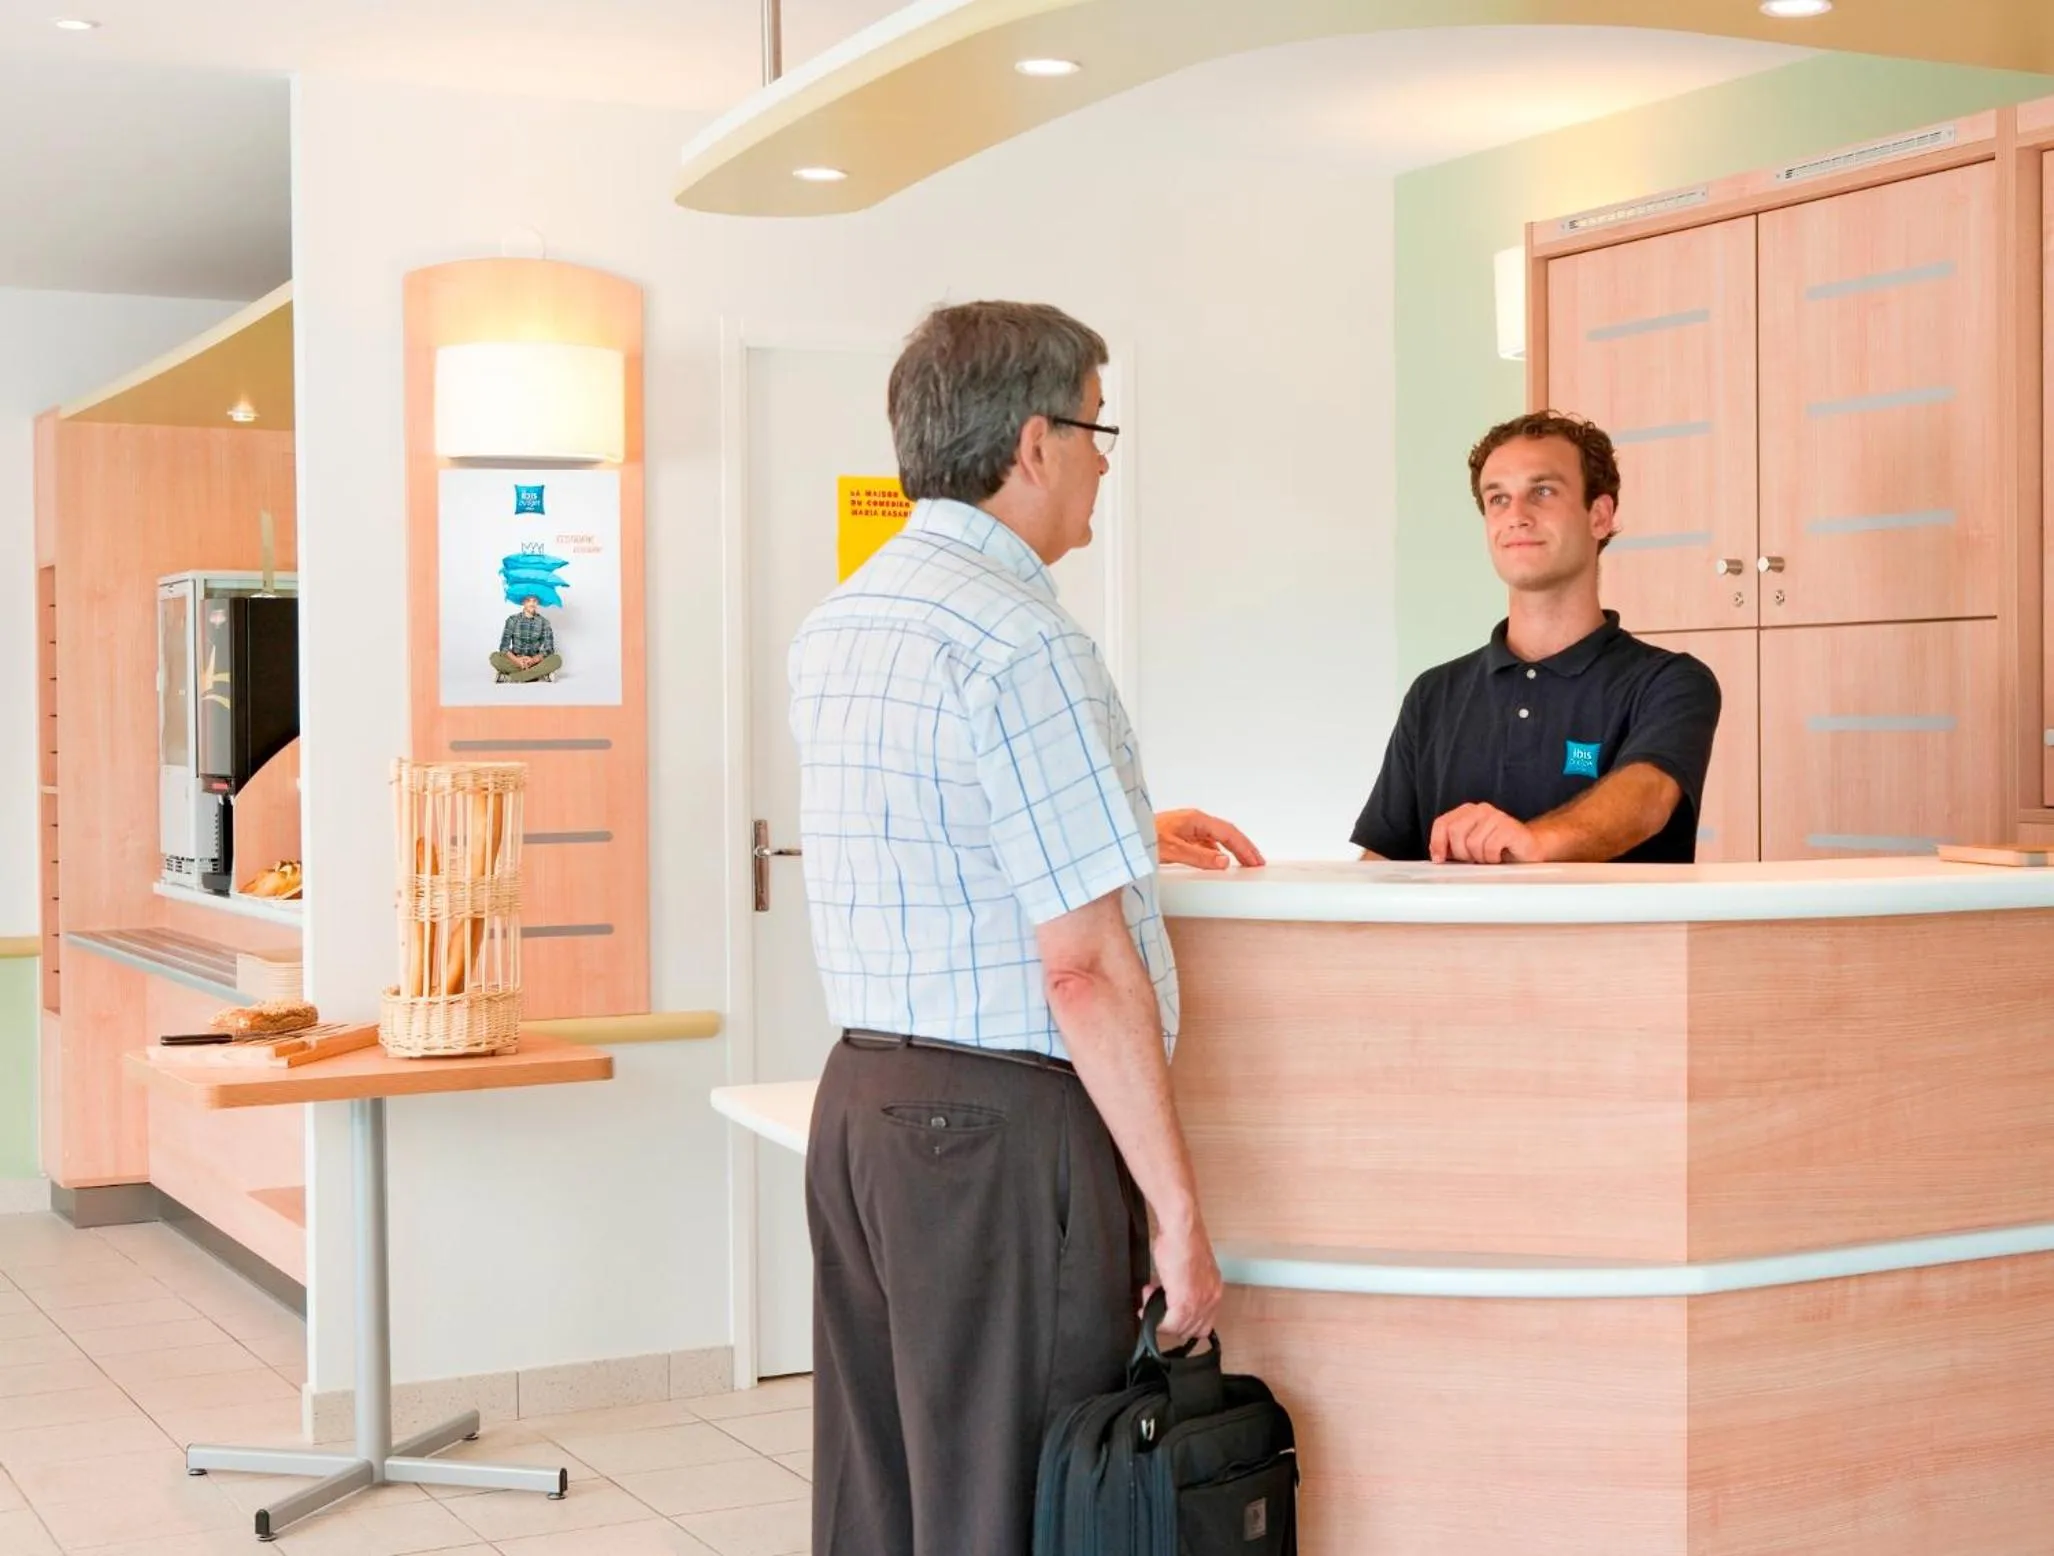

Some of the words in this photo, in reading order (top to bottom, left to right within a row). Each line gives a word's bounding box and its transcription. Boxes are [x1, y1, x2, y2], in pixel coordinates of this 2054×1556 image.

[865, 490, 899, 498] MAISON
[851, 509, 878, 517] MARIA
[1572, 747, 1592, 760] ibis
